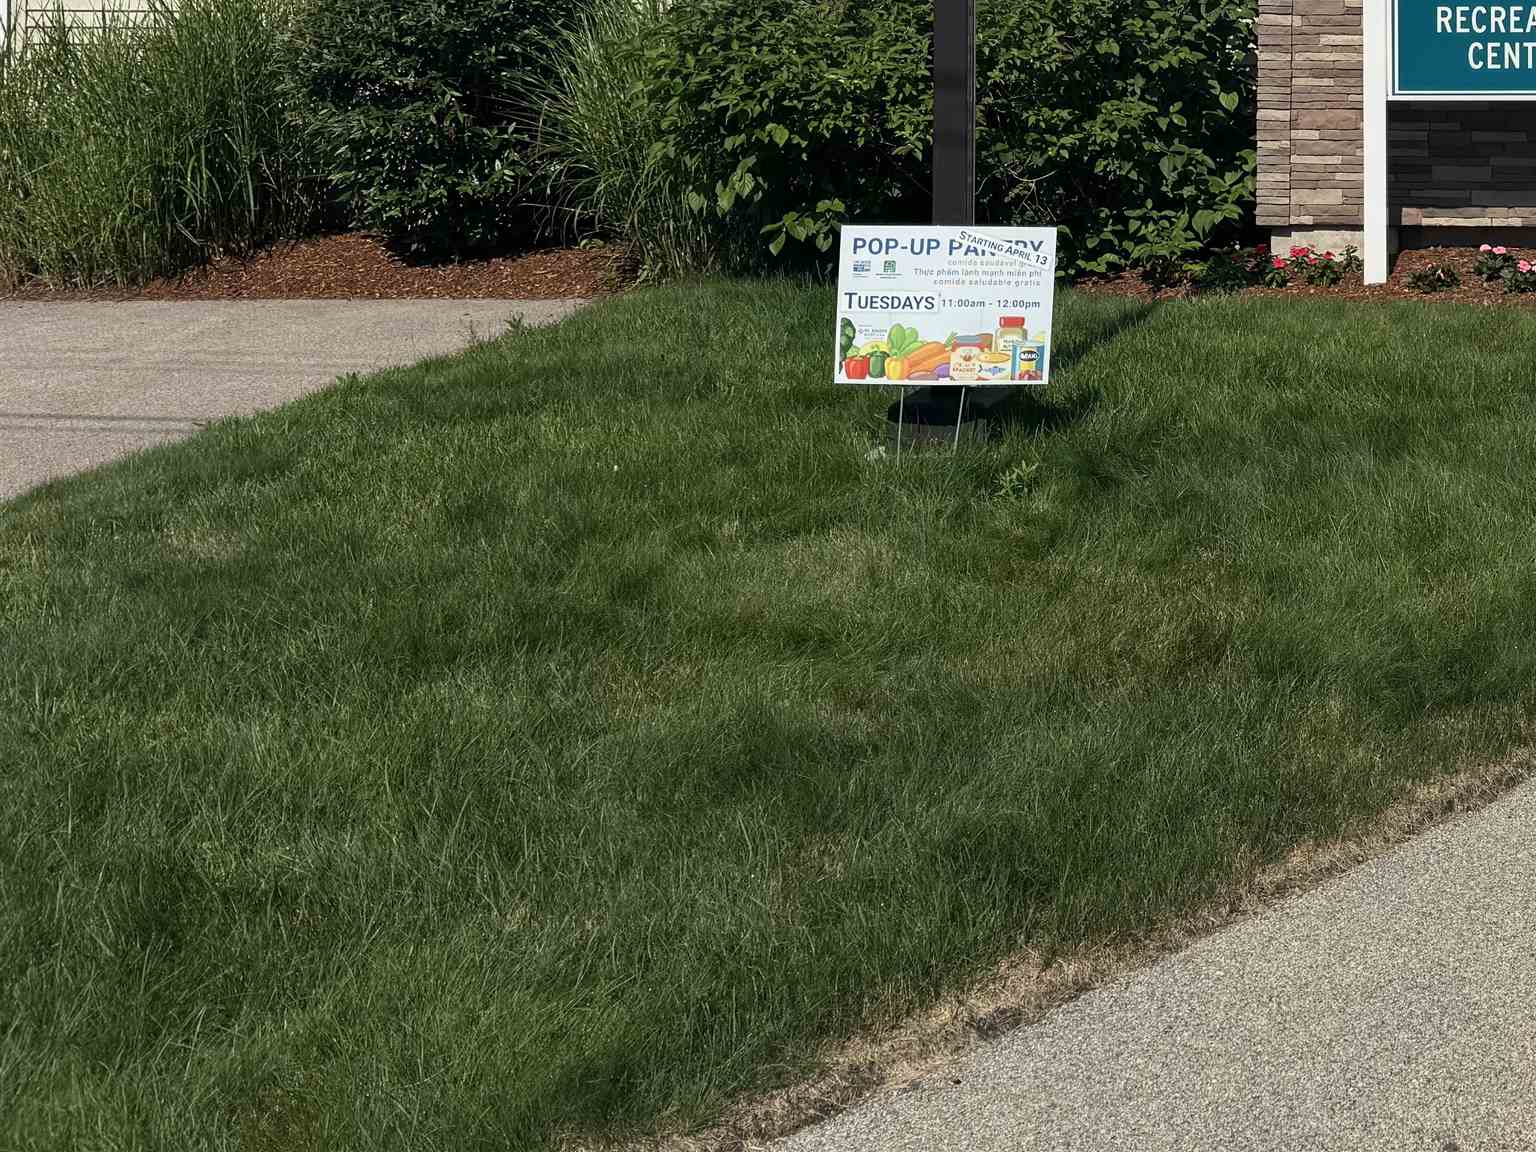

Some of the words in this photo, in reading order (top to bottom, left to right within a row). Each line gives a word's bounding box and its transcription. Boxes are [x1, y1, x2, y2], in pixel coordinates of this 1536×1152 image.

[852, 237, 940, 256] POP-UP
[959, 231, 1004, 252] STARTING
[1005, 246, 1031, 261] APRIL
[1035, 254, 1048, 265] 13
[844, 292, 935, 310] TUESDAYS
[941, 299, 985, 308] 11:00am
[997, 299, 1040, 310] 12:00pm
